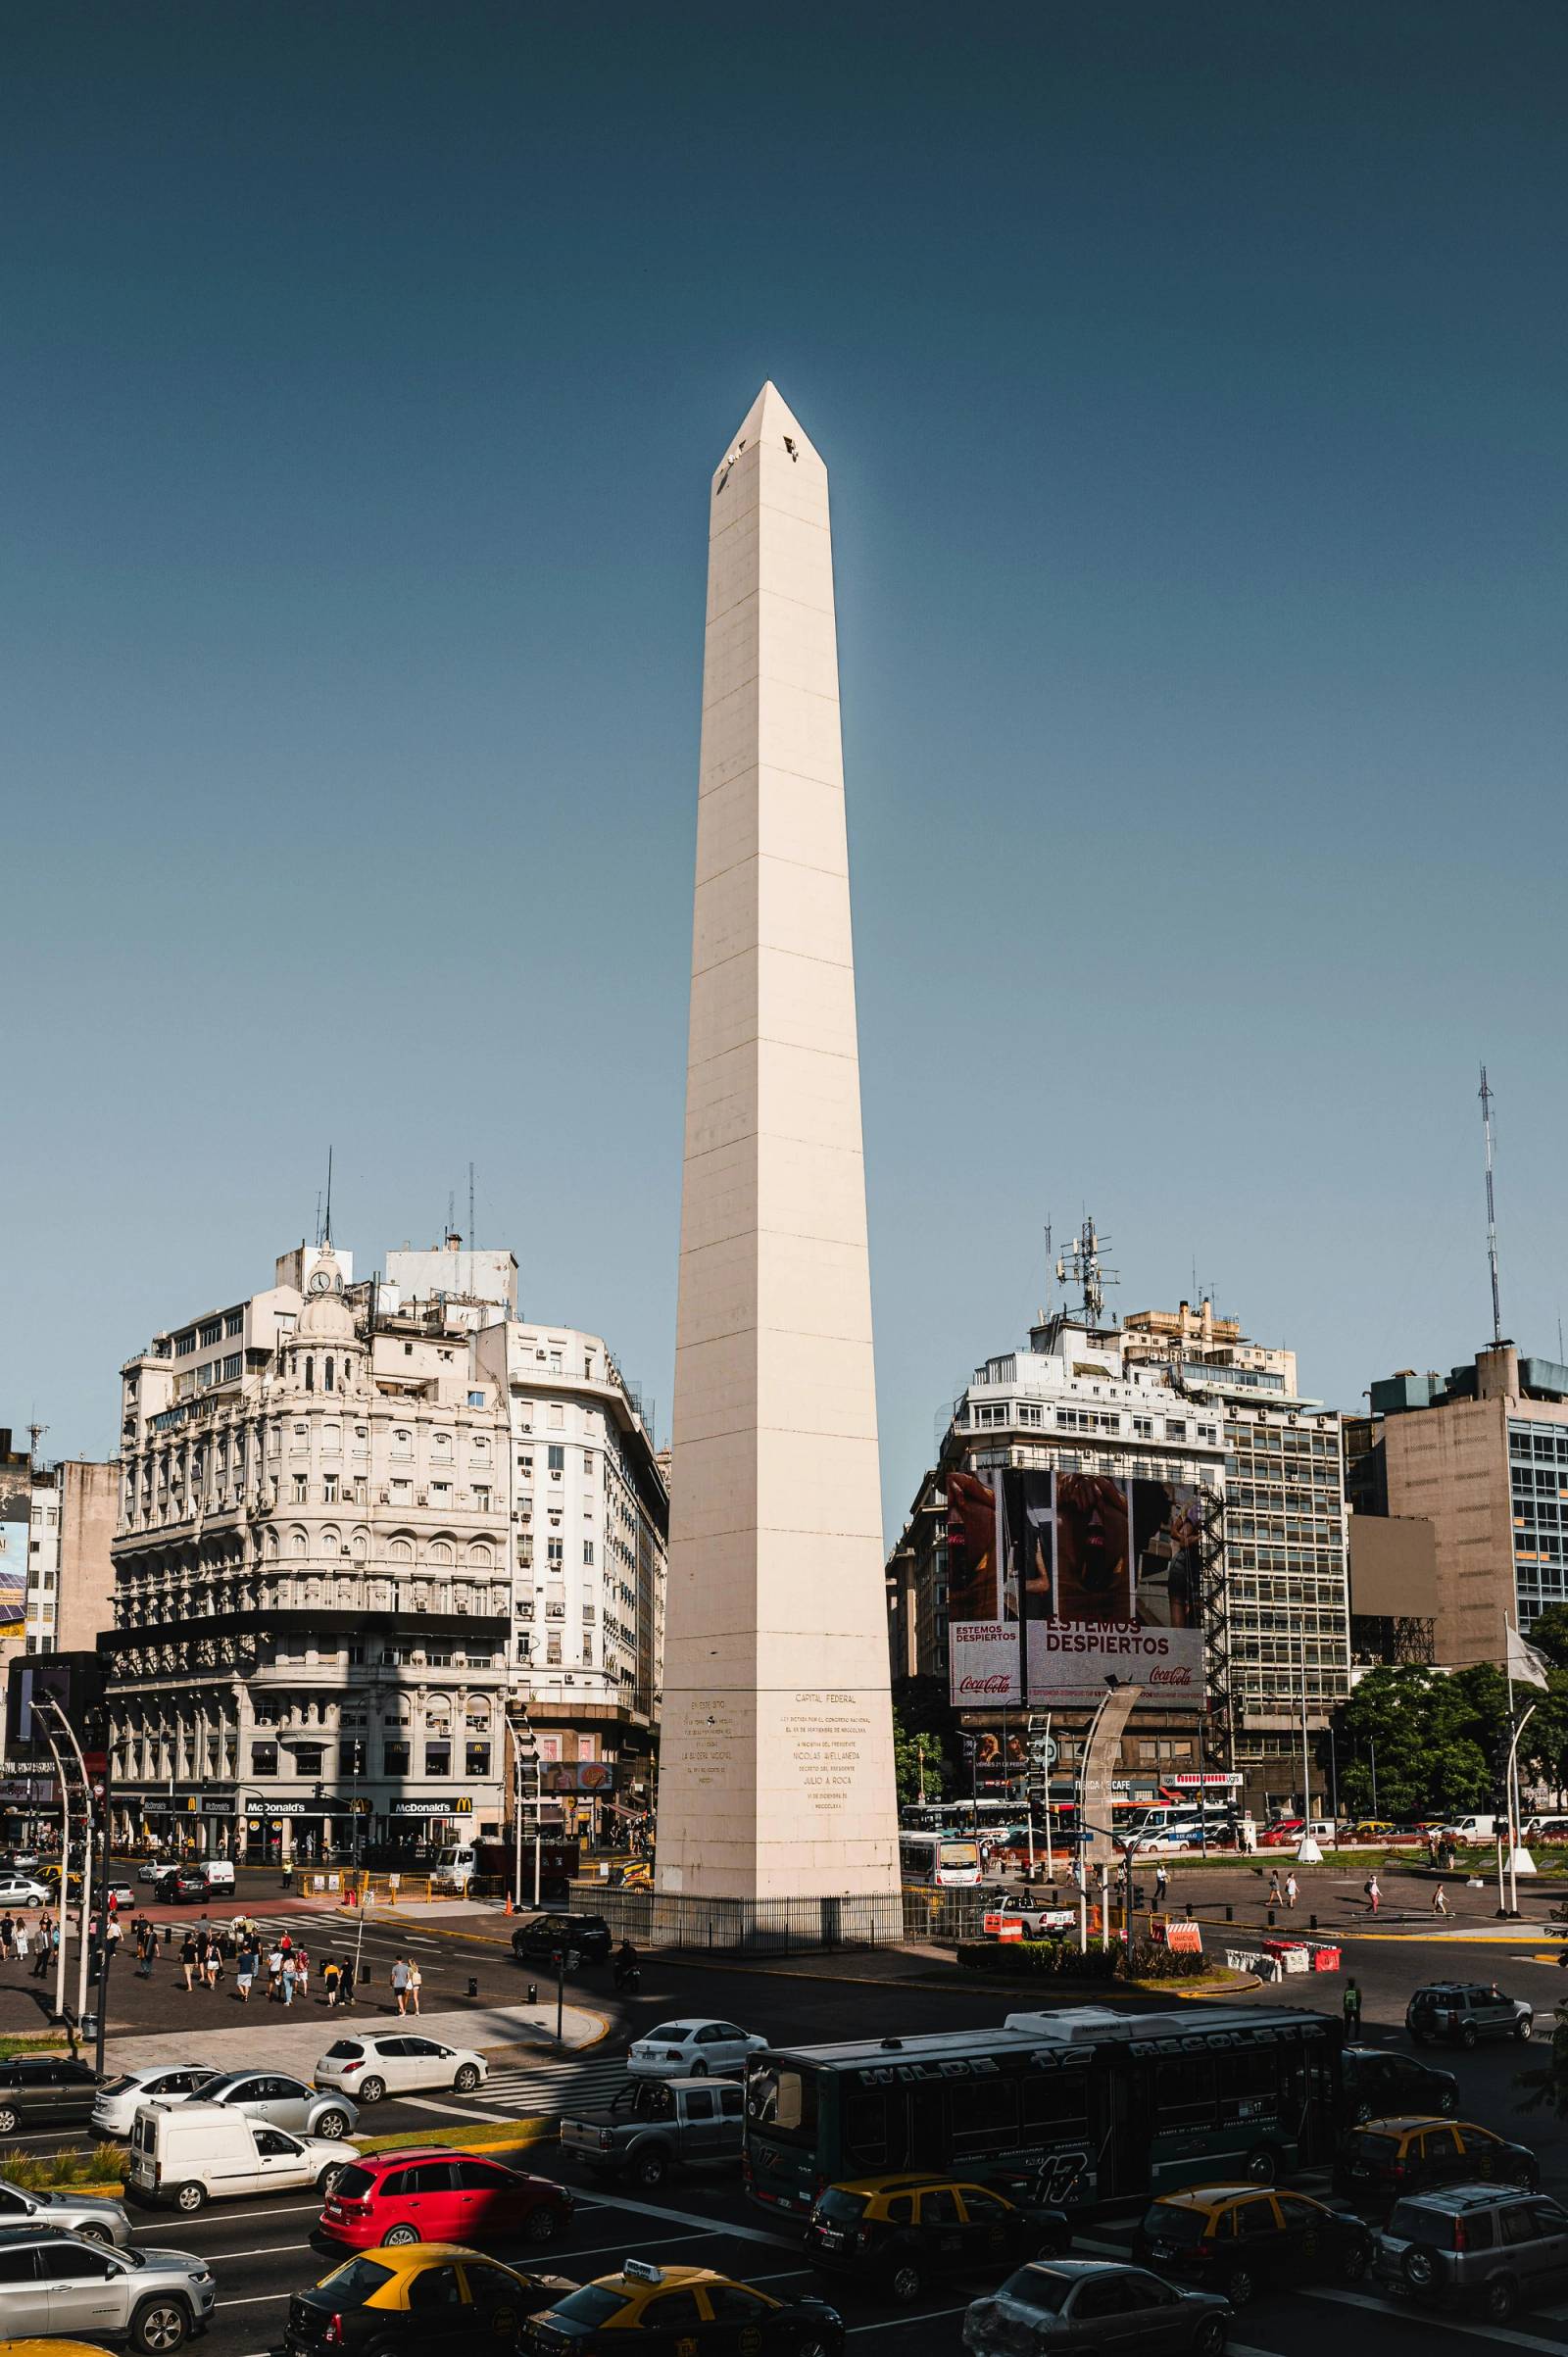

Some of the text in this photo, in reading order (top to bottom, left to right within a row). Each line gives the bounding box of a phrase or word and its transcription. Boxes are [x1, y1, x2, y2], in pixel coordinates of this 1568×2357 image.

[956, 1625, 1003, 1634] ESTEMOS
[956, 1633, 1016, 1643] DESPIERTOS
[1046, 1634, 1169, 1655] DESPIERTOS
[795, 1694, 857, 1703] CAPITAL FEDERAL
[804, 1776, 823, 1785] JULIO
[832, 1776, 852, 1785] ROCA
[1111, 1780, 1131, 1790] CAFE
[247, 1802, 306, 1813] McDonald's
[395, 1802, 451, 1813] McDonald's
[858, 2023, 1328, 2087] WILDE 17 RECOLETA
[758, 2145, 780, 2170] 17
